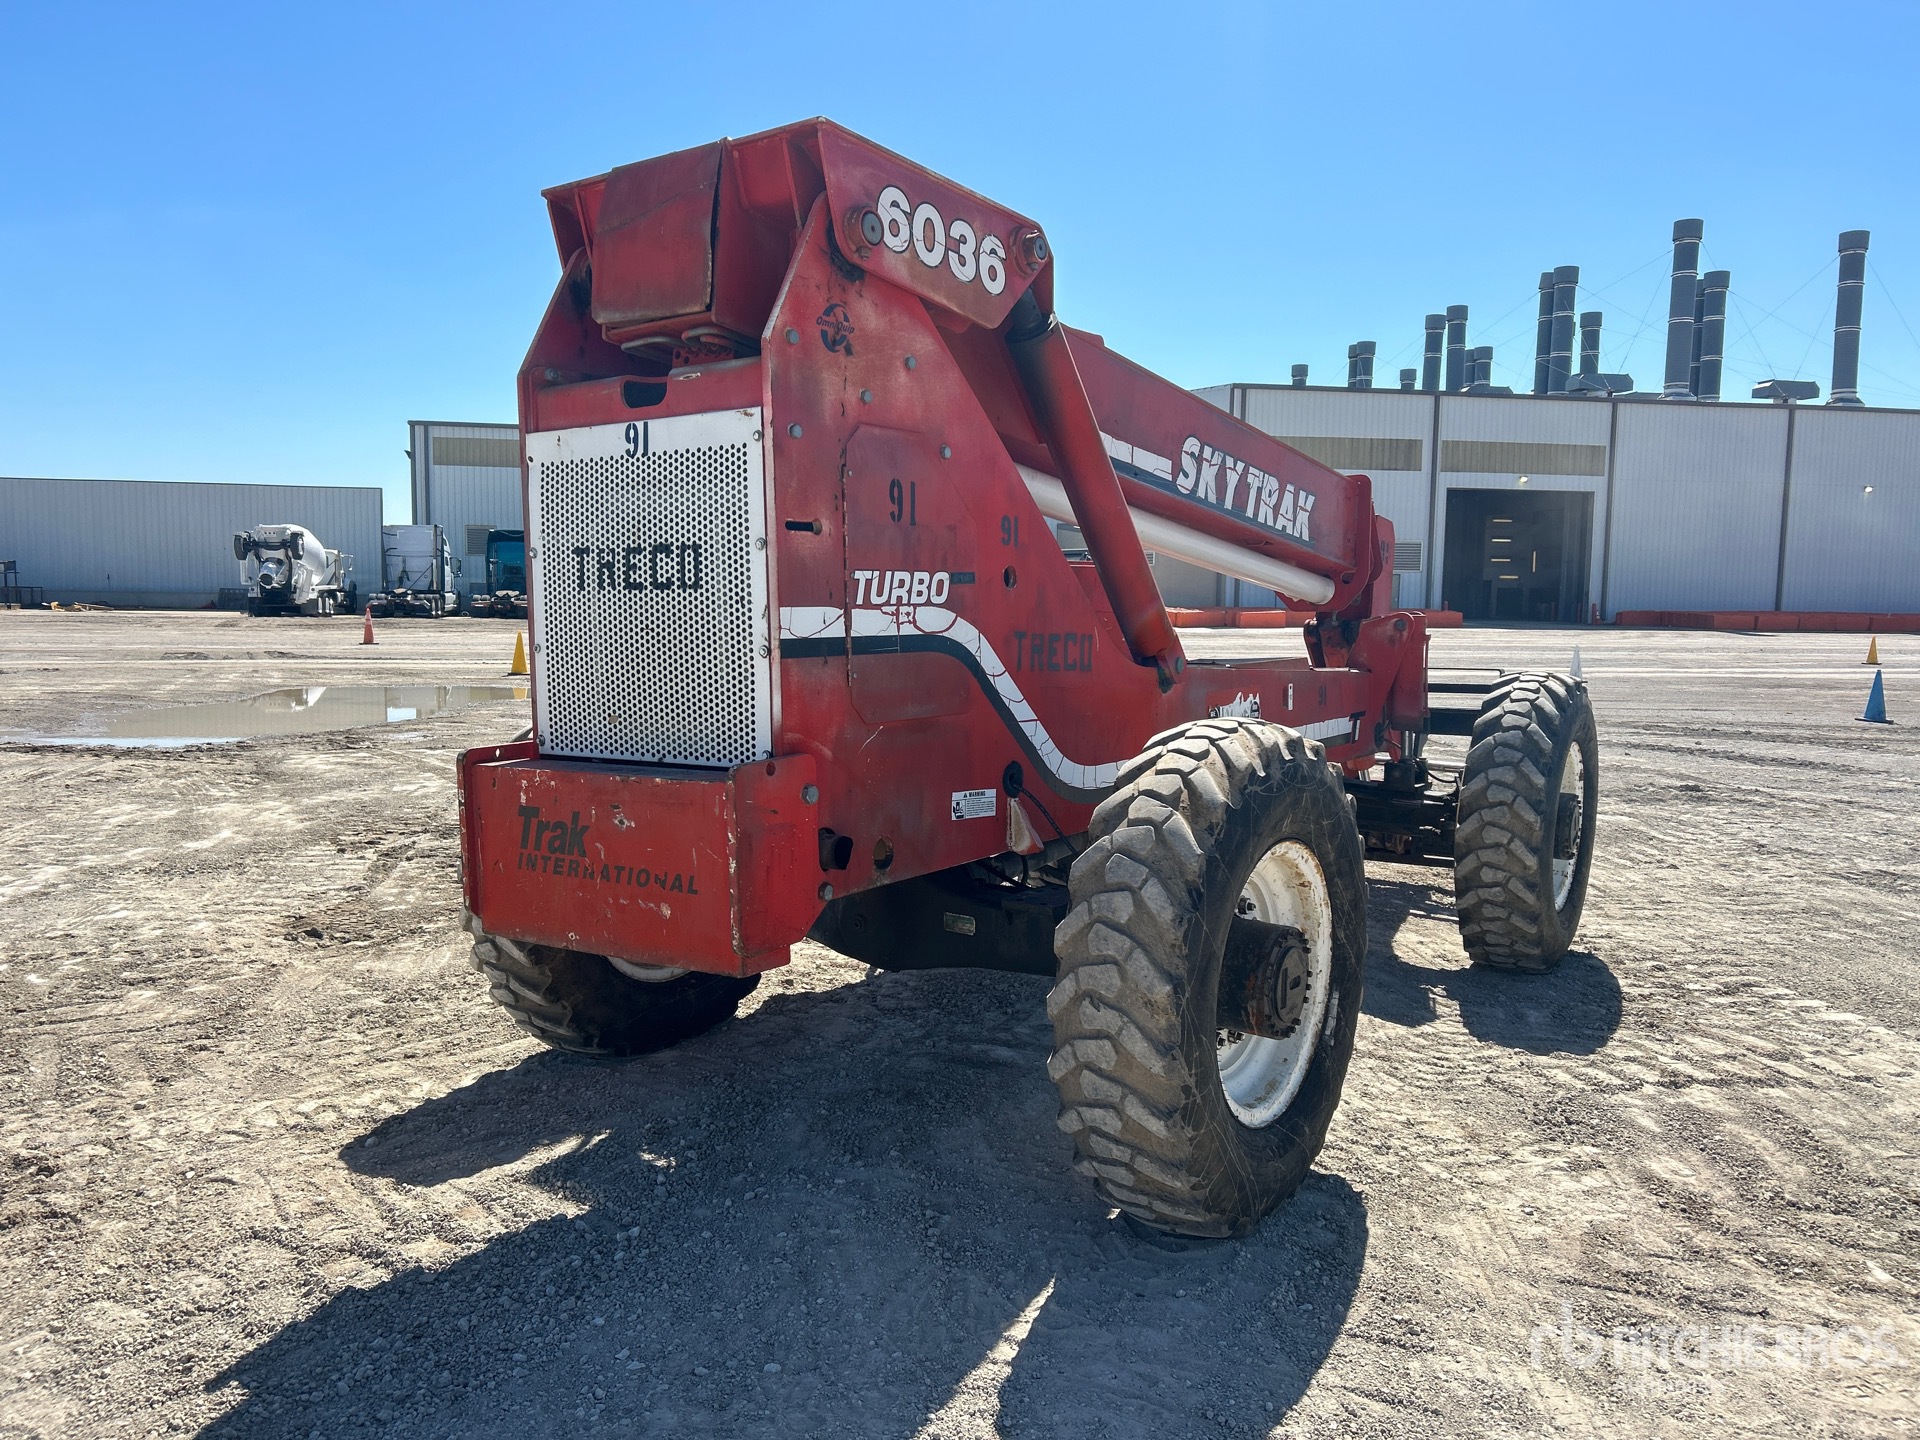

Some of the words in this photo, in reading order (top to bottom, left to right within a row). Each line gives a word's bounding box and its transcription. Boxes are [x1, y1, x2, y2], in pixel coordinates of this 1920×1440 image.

[877, 185, 1006, 295] 6036
[625, 421, 649, 458] 91
[889, 478, 916, 526] 91
[1001, 515, 1018, 547] 91
[571, 543, 701, 592] TRECO
[854, 570, 950, 605] TURBO
[1014, 631, 1093, 672] TRECO
[518, 805, 590, 858] Trak
[517, 852, 699, 895] INTERNATIONAL
